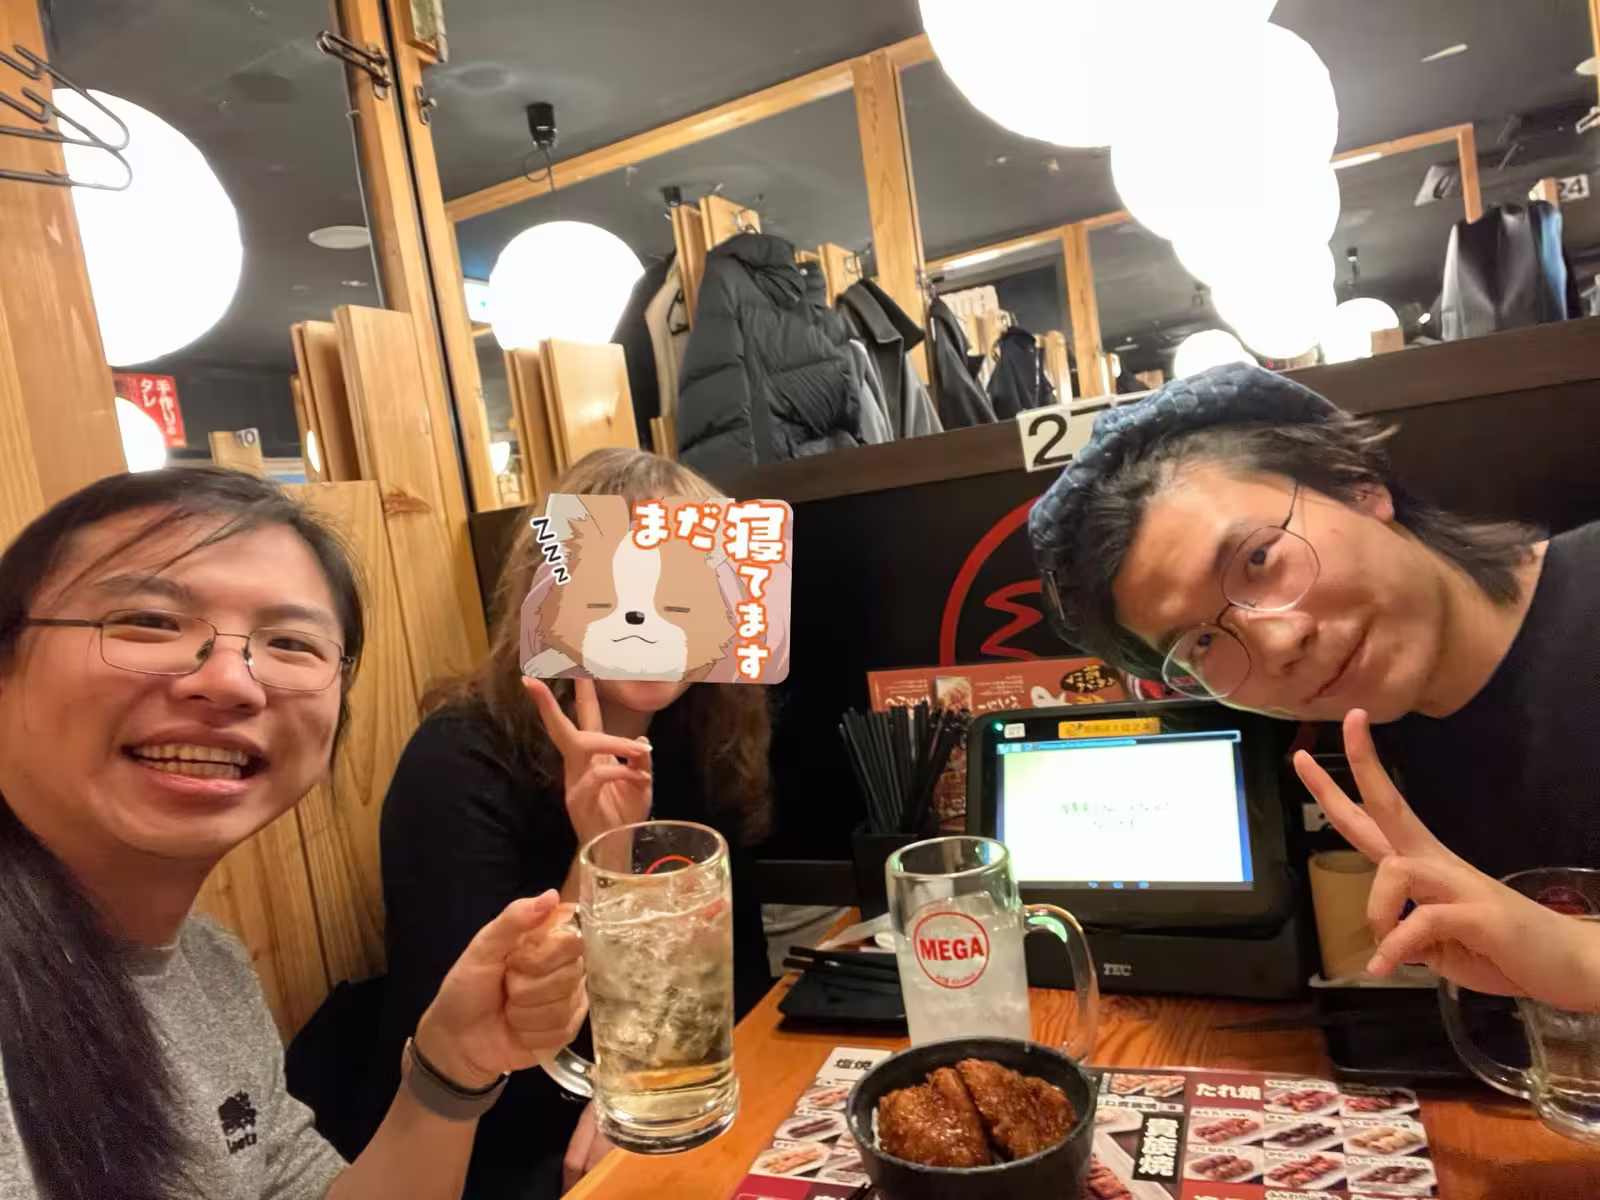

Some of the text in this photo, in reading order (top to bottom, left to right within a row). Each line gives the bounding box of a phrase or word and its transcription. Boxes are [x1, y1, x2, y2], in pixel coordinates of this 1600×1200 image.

[236, 430, 257, 448] 10
[919, 935, 985, 961] MEGA
[1103, 963, 1132, 977] TEC
[1138, 1117, 1180, 1177] 貴族焼
